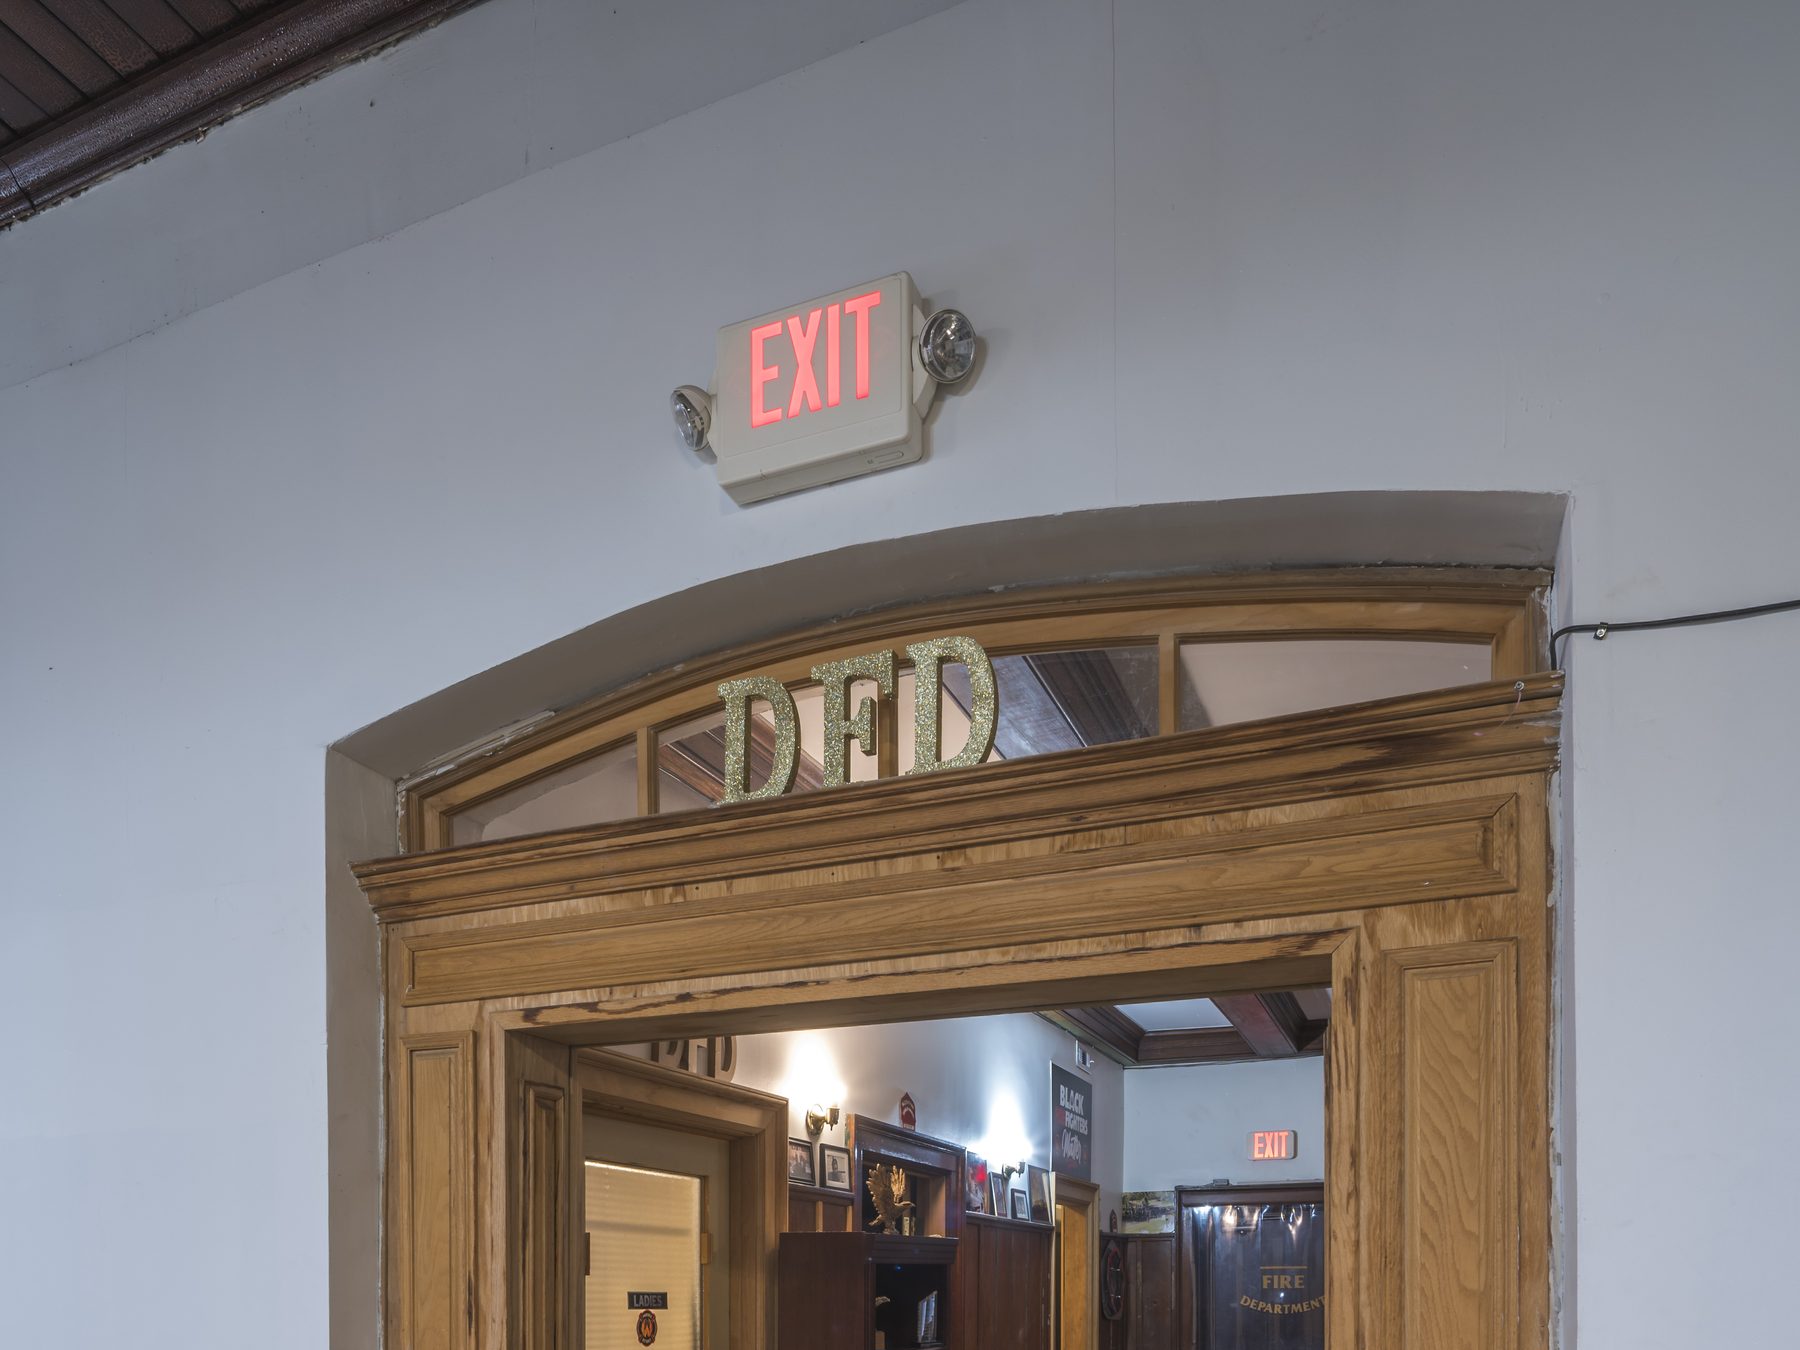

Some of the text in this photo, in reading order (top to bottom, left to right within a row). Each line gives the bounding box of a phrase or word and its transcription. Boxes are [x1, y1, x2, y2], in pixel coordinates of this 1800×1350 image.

[751, 290, 881, 429] EXIT
[717, 635, 999, 808] DFD
[1060, 1084, 1084, 1115] BLACK
[1253, 1131, 1289, 1159] EXIT
[1262, 1274, 1305, 1289] FIRE
[633, 1294, 662, 1307] LADIES
